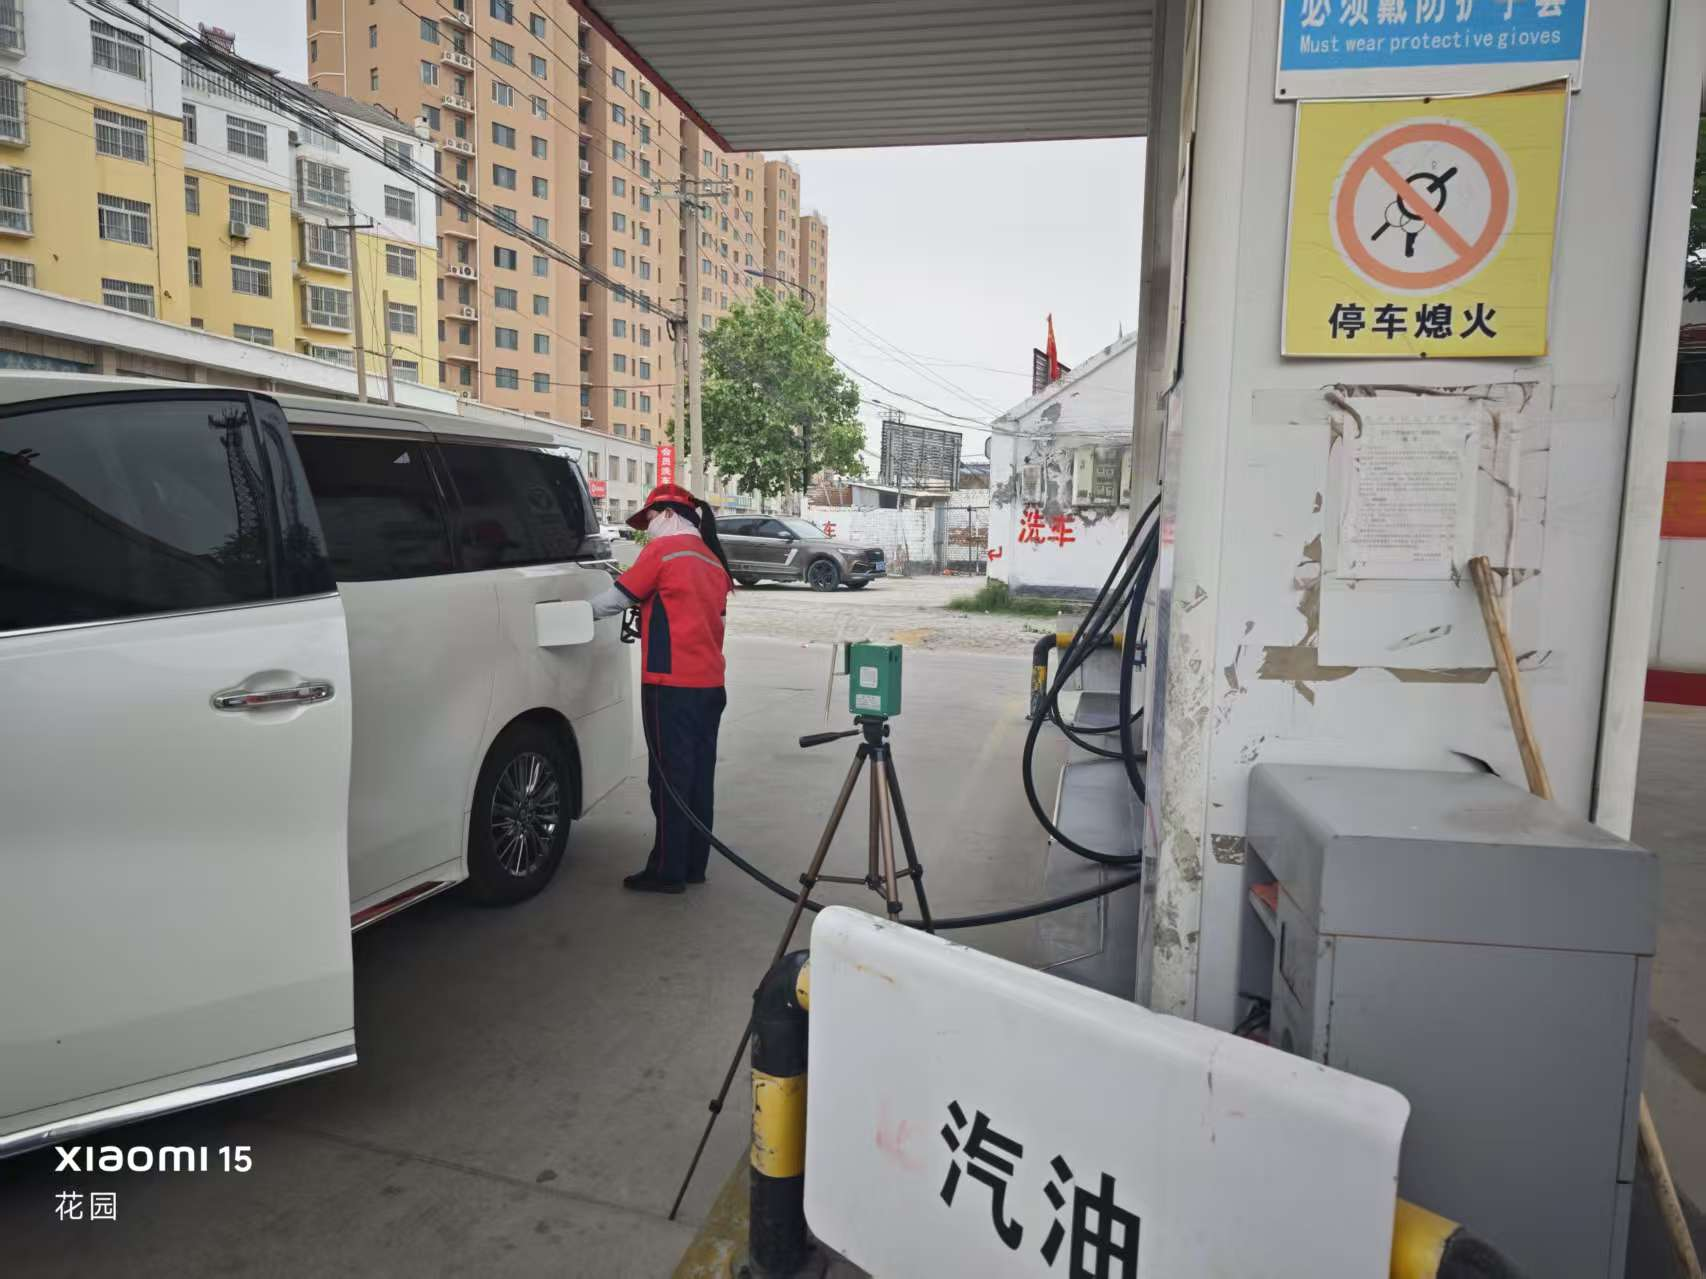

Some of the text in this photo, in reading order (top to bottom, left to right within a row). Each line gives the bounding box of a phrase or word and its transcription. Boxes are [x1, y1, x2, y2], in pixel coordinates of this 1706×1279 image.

[1300, 34, 1339, 53] Must
[1345, 38, 1385, 52] wear
[1391, 29, 1493, 53] protective
[1328, 302, 1498, 340] 停车熄火
[1018, 508, 1076, 547] 洗车
[940, 1099, 1141, 1279] 汽油
